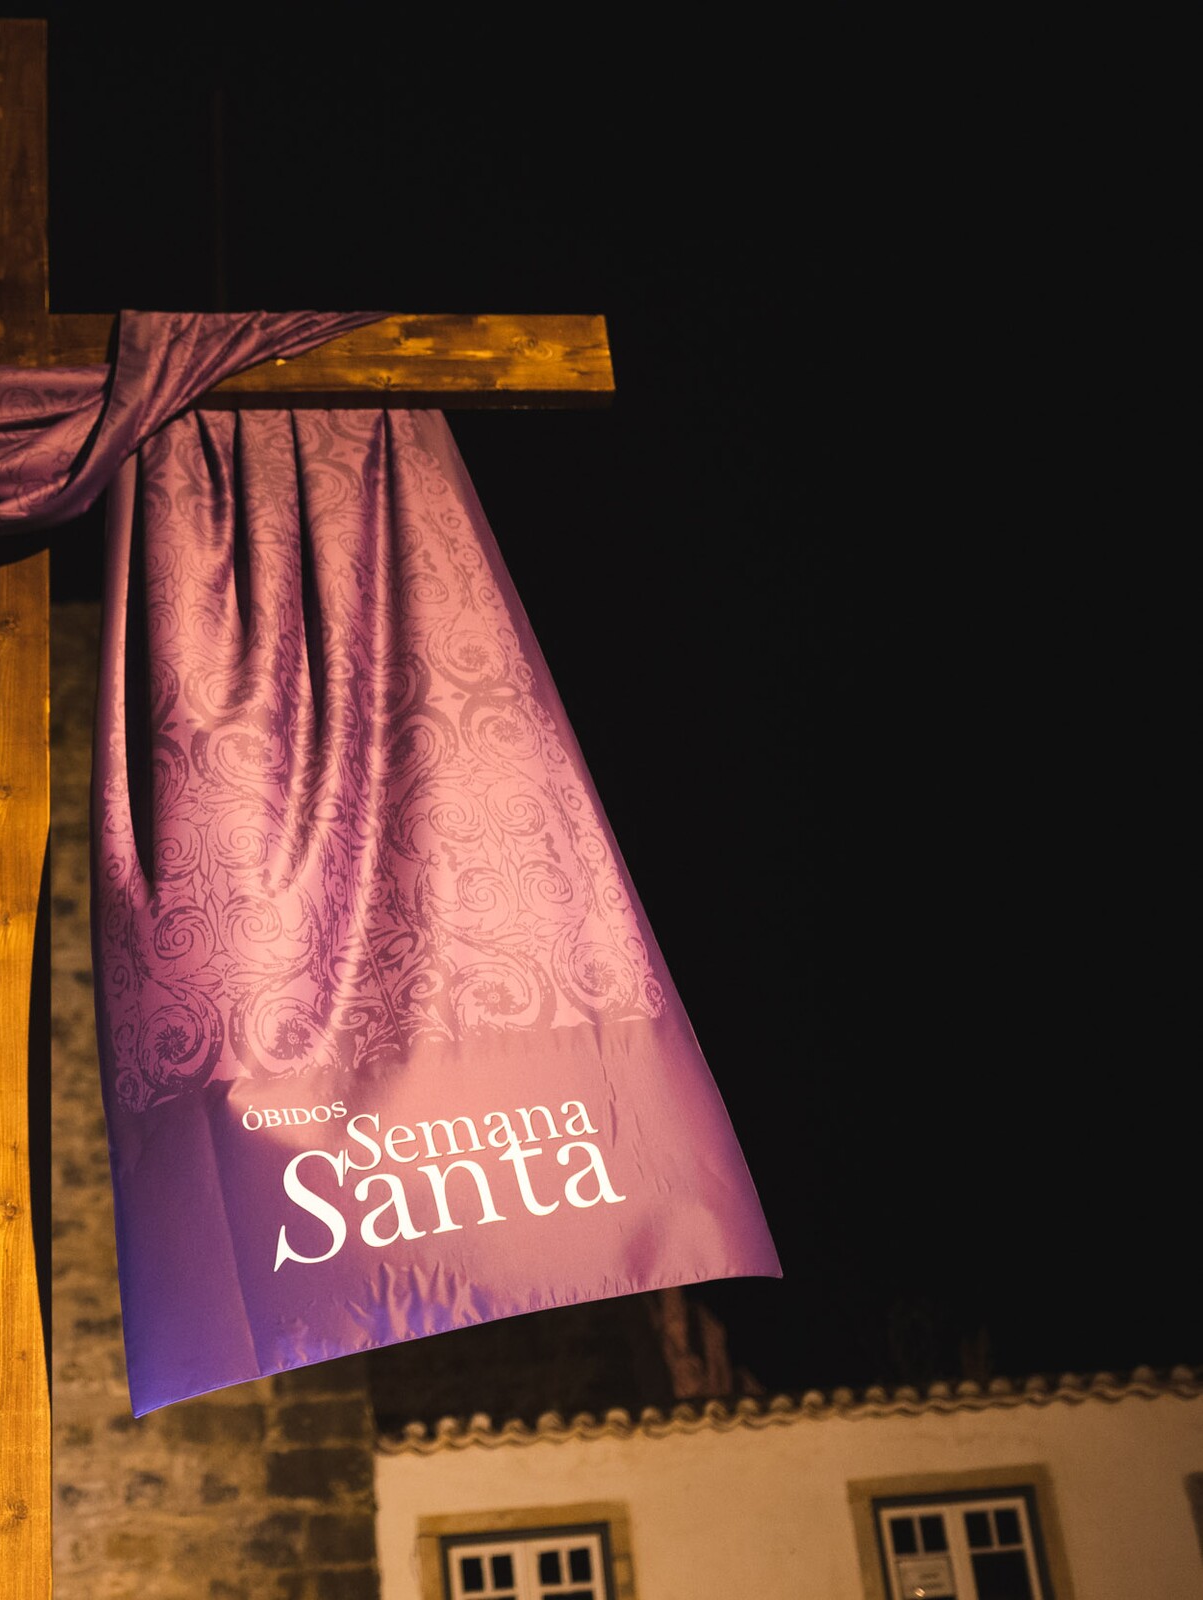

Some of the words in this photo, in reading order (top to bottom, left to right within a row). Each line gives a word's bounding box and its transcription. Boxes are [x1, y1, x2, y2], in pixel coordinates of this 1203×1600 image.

[242, 1101, 348, 1131] ÓBIDOS
[345, 1099, 598, 1175] Semana
[273, 1131, 626, 1272] Santa
